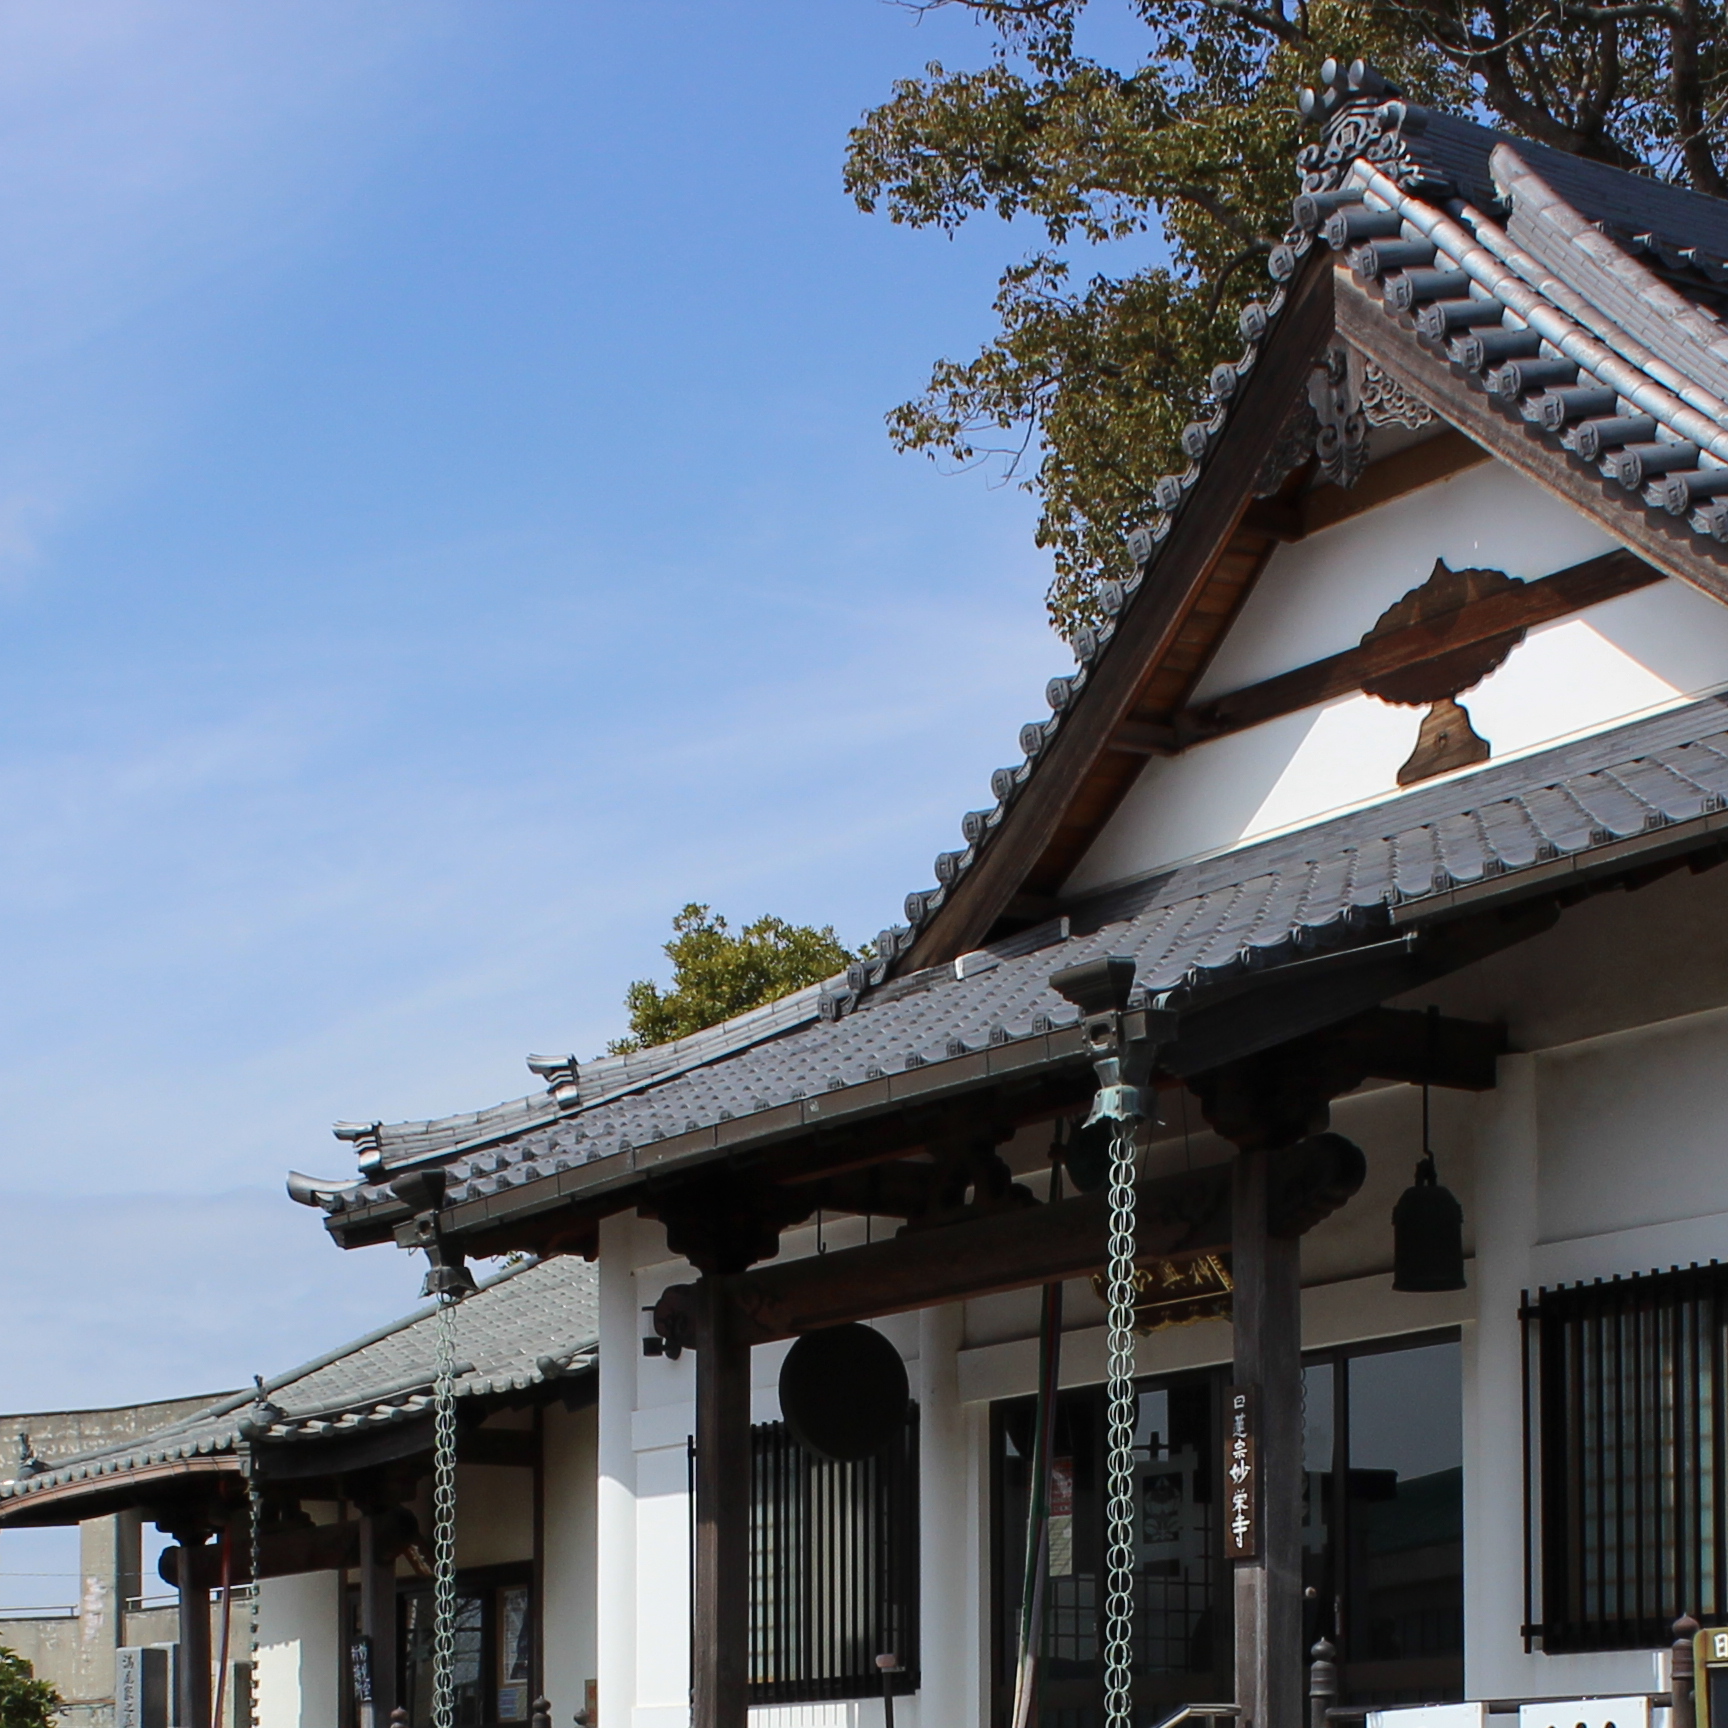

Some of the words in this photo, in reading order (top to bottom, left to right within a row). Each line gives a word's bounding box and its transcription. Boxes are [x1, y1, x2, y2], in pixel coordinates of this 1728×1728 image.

[1229, 1395, 1251, 1548] 日蓮宗妙栄寺
